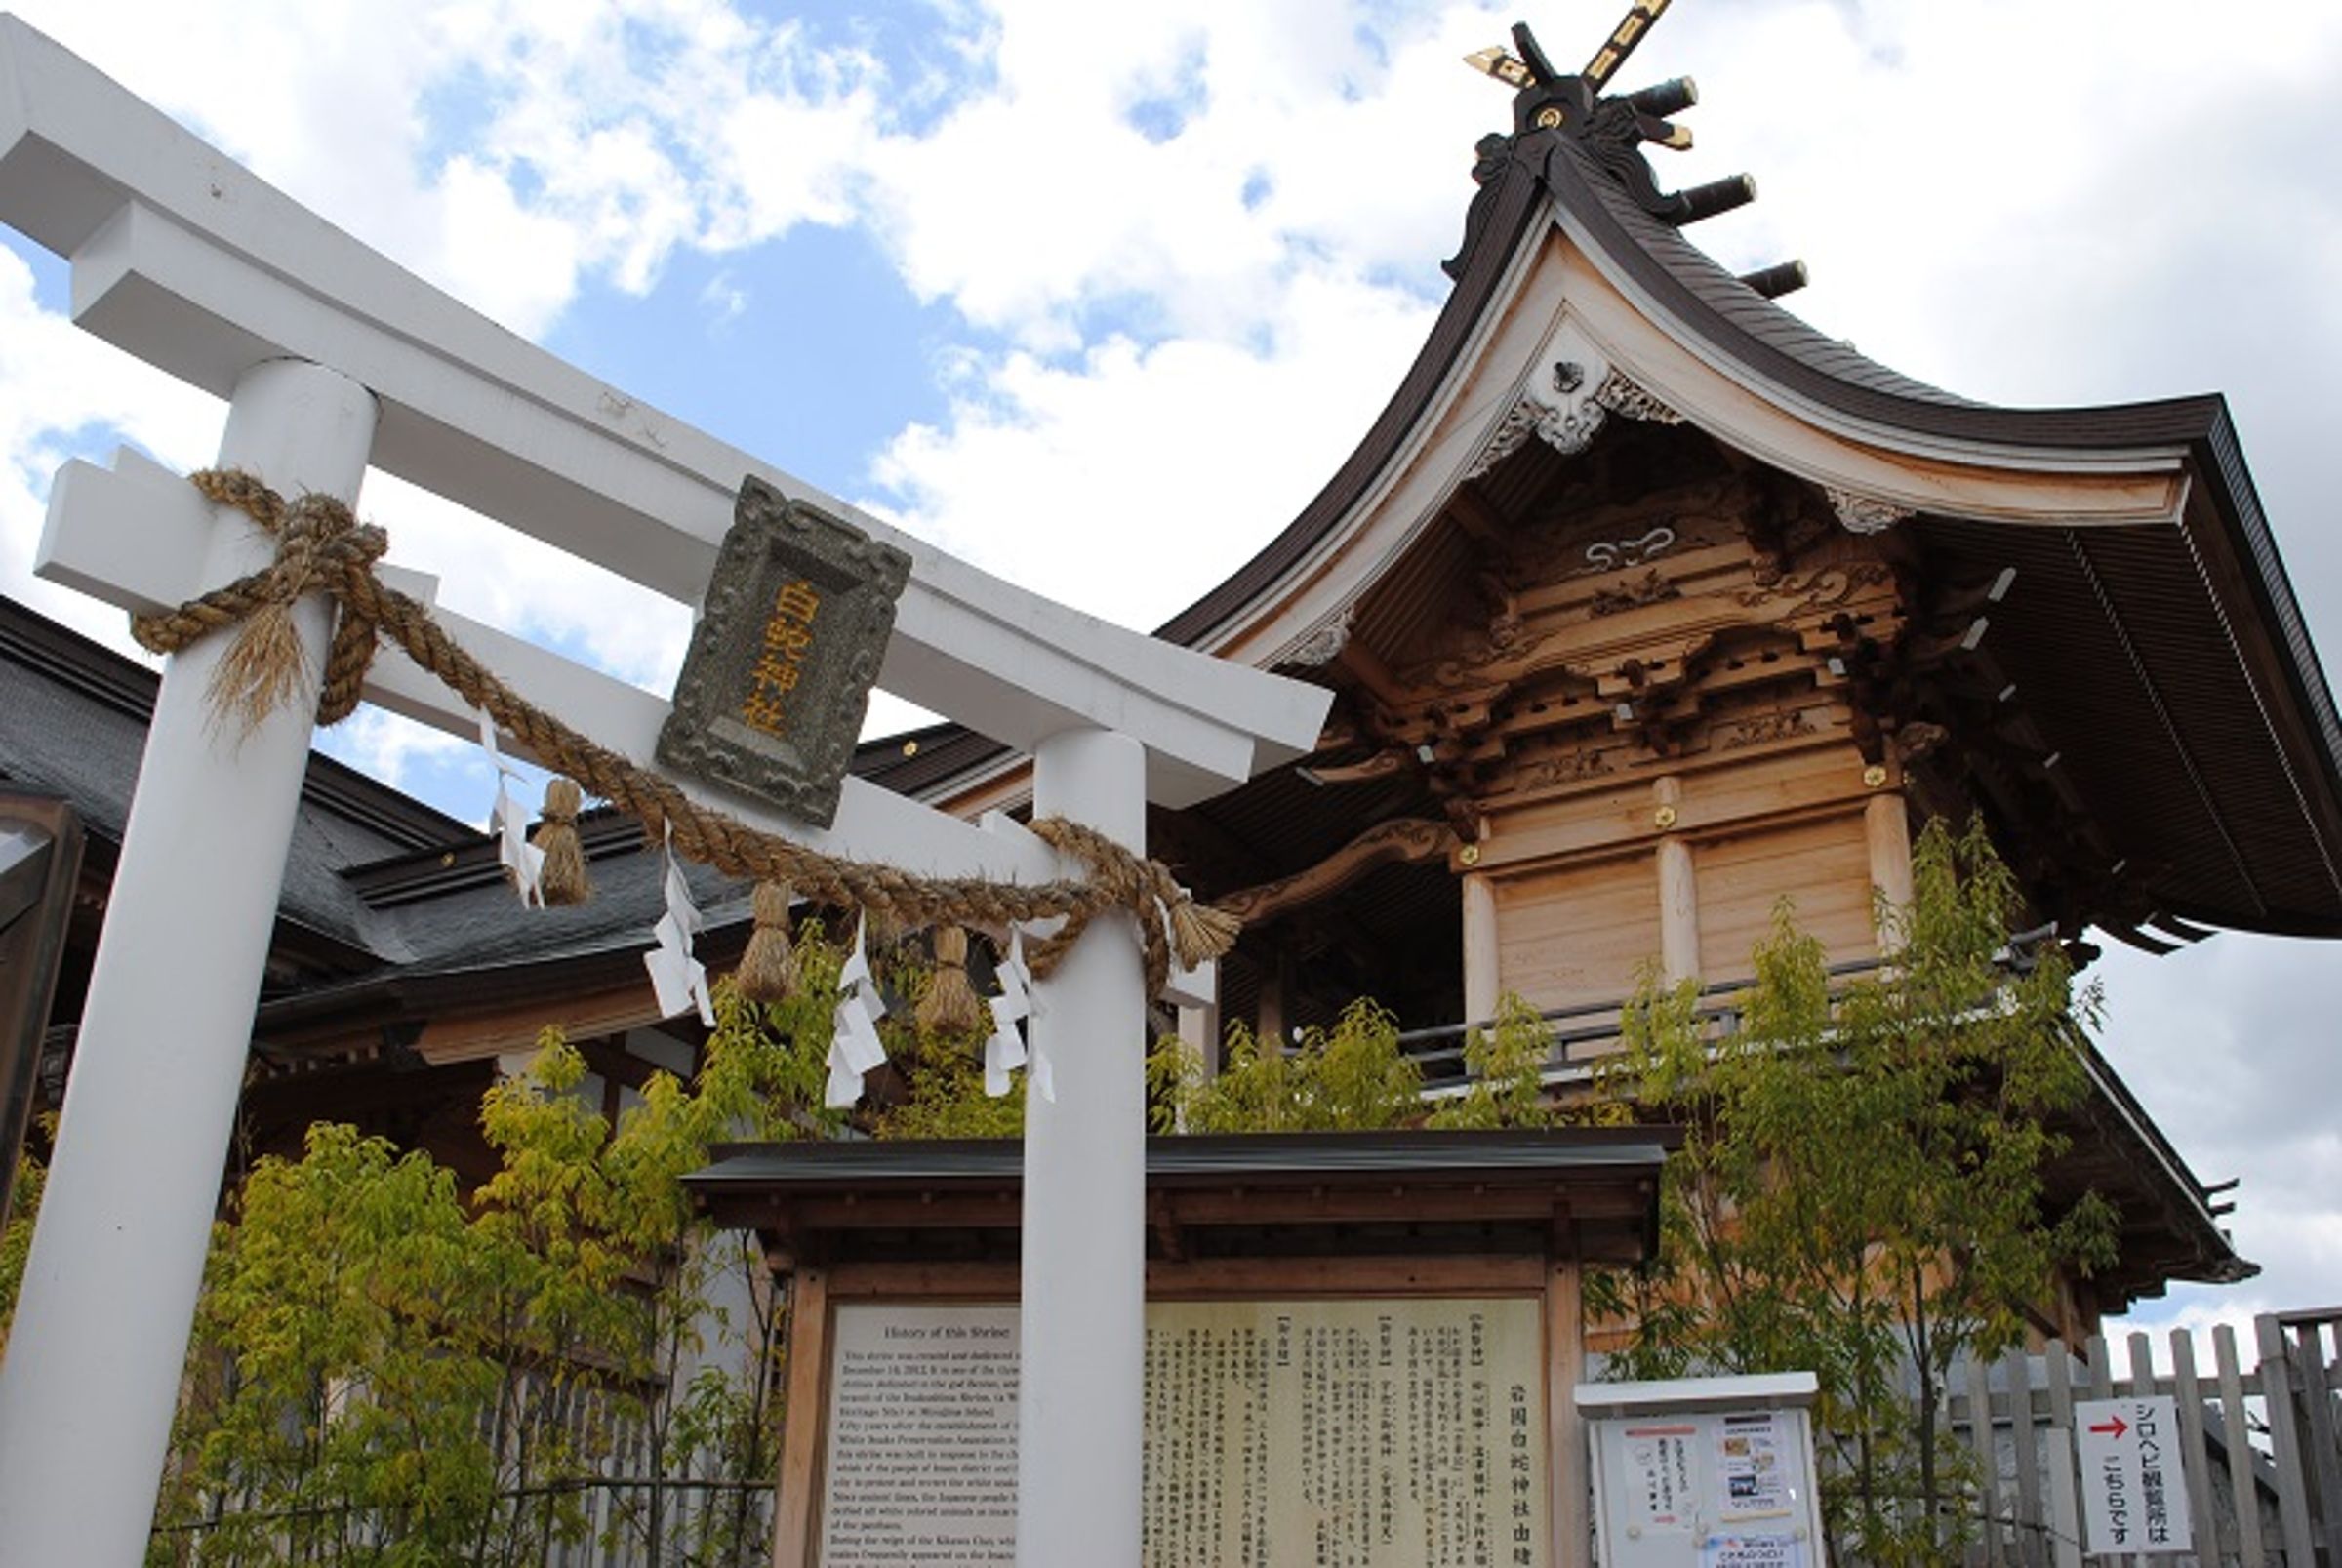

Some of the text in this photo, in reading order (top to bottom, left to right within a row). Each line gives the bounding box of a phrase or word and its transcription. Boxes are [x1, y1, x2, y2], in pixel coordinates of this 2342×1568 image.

[885, 1327, 1009, 1339] History of this Shrine
[2103, 1455, 2130, 1545] こちらです
